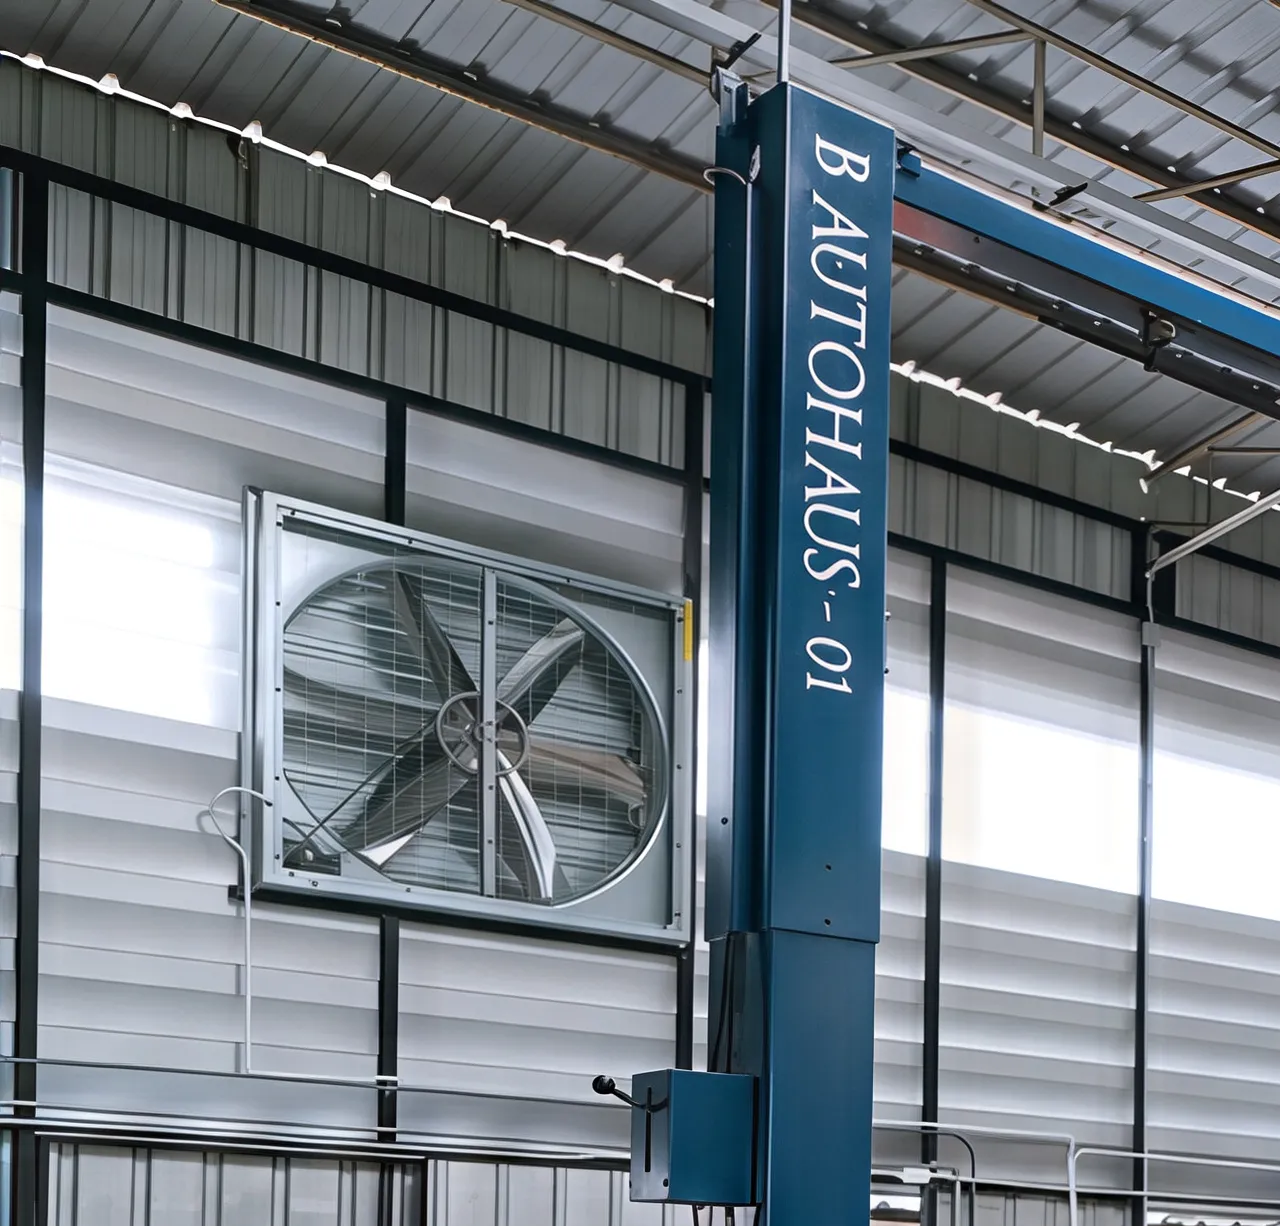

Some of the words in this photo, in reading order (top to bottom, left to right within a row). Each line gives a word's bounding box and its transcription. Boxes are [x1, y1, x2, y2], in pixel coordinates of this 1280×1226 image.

[815, 132, 871, 183] B
[803, 188, 870, 590] AUTOHAUS
[805, 636, 853, 694] 01
